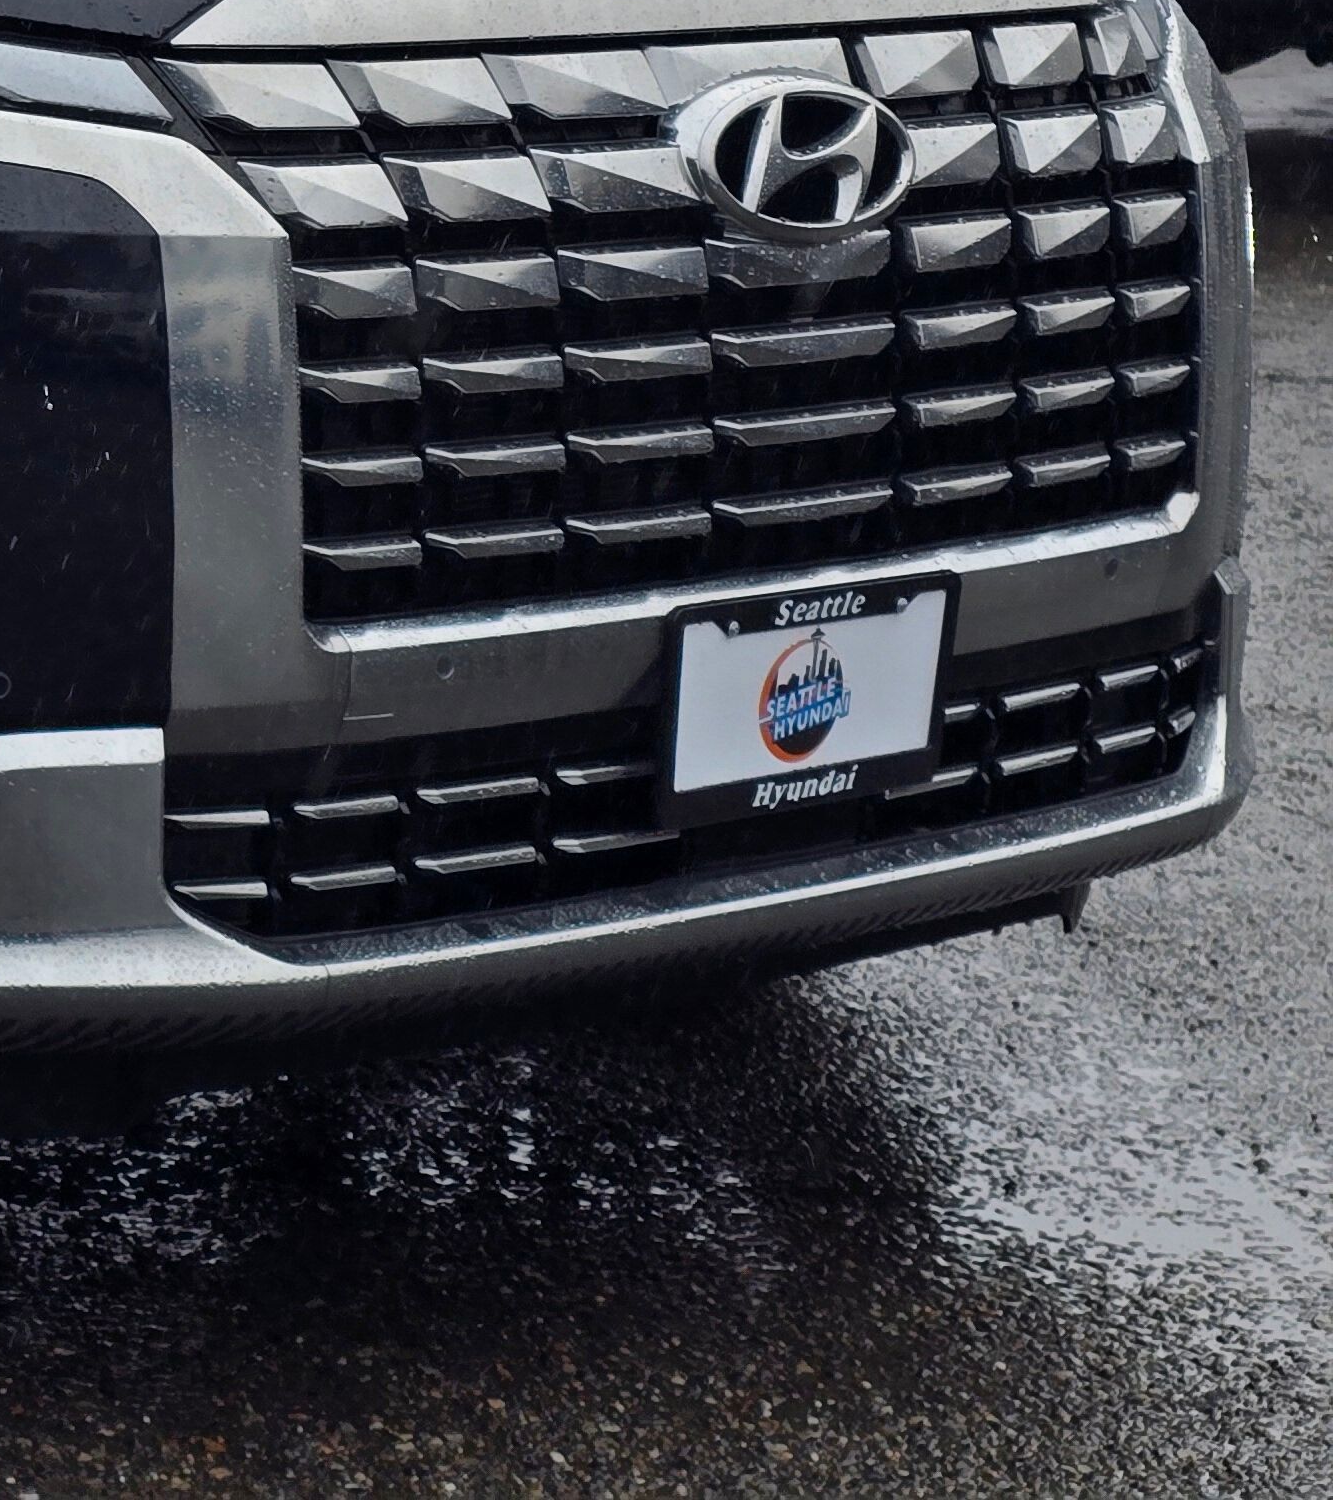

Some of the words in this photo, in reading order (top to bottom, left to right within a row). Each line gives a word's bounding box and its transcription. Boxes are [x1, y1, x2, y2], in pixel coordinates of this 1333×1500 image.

[774, 591, 866, 626] Seattle
[766, 678, 836, 719] SEATTLE
[773, 693, 850, 741] HYUNDAI
[752, 764, 859, 810] Hyundai
